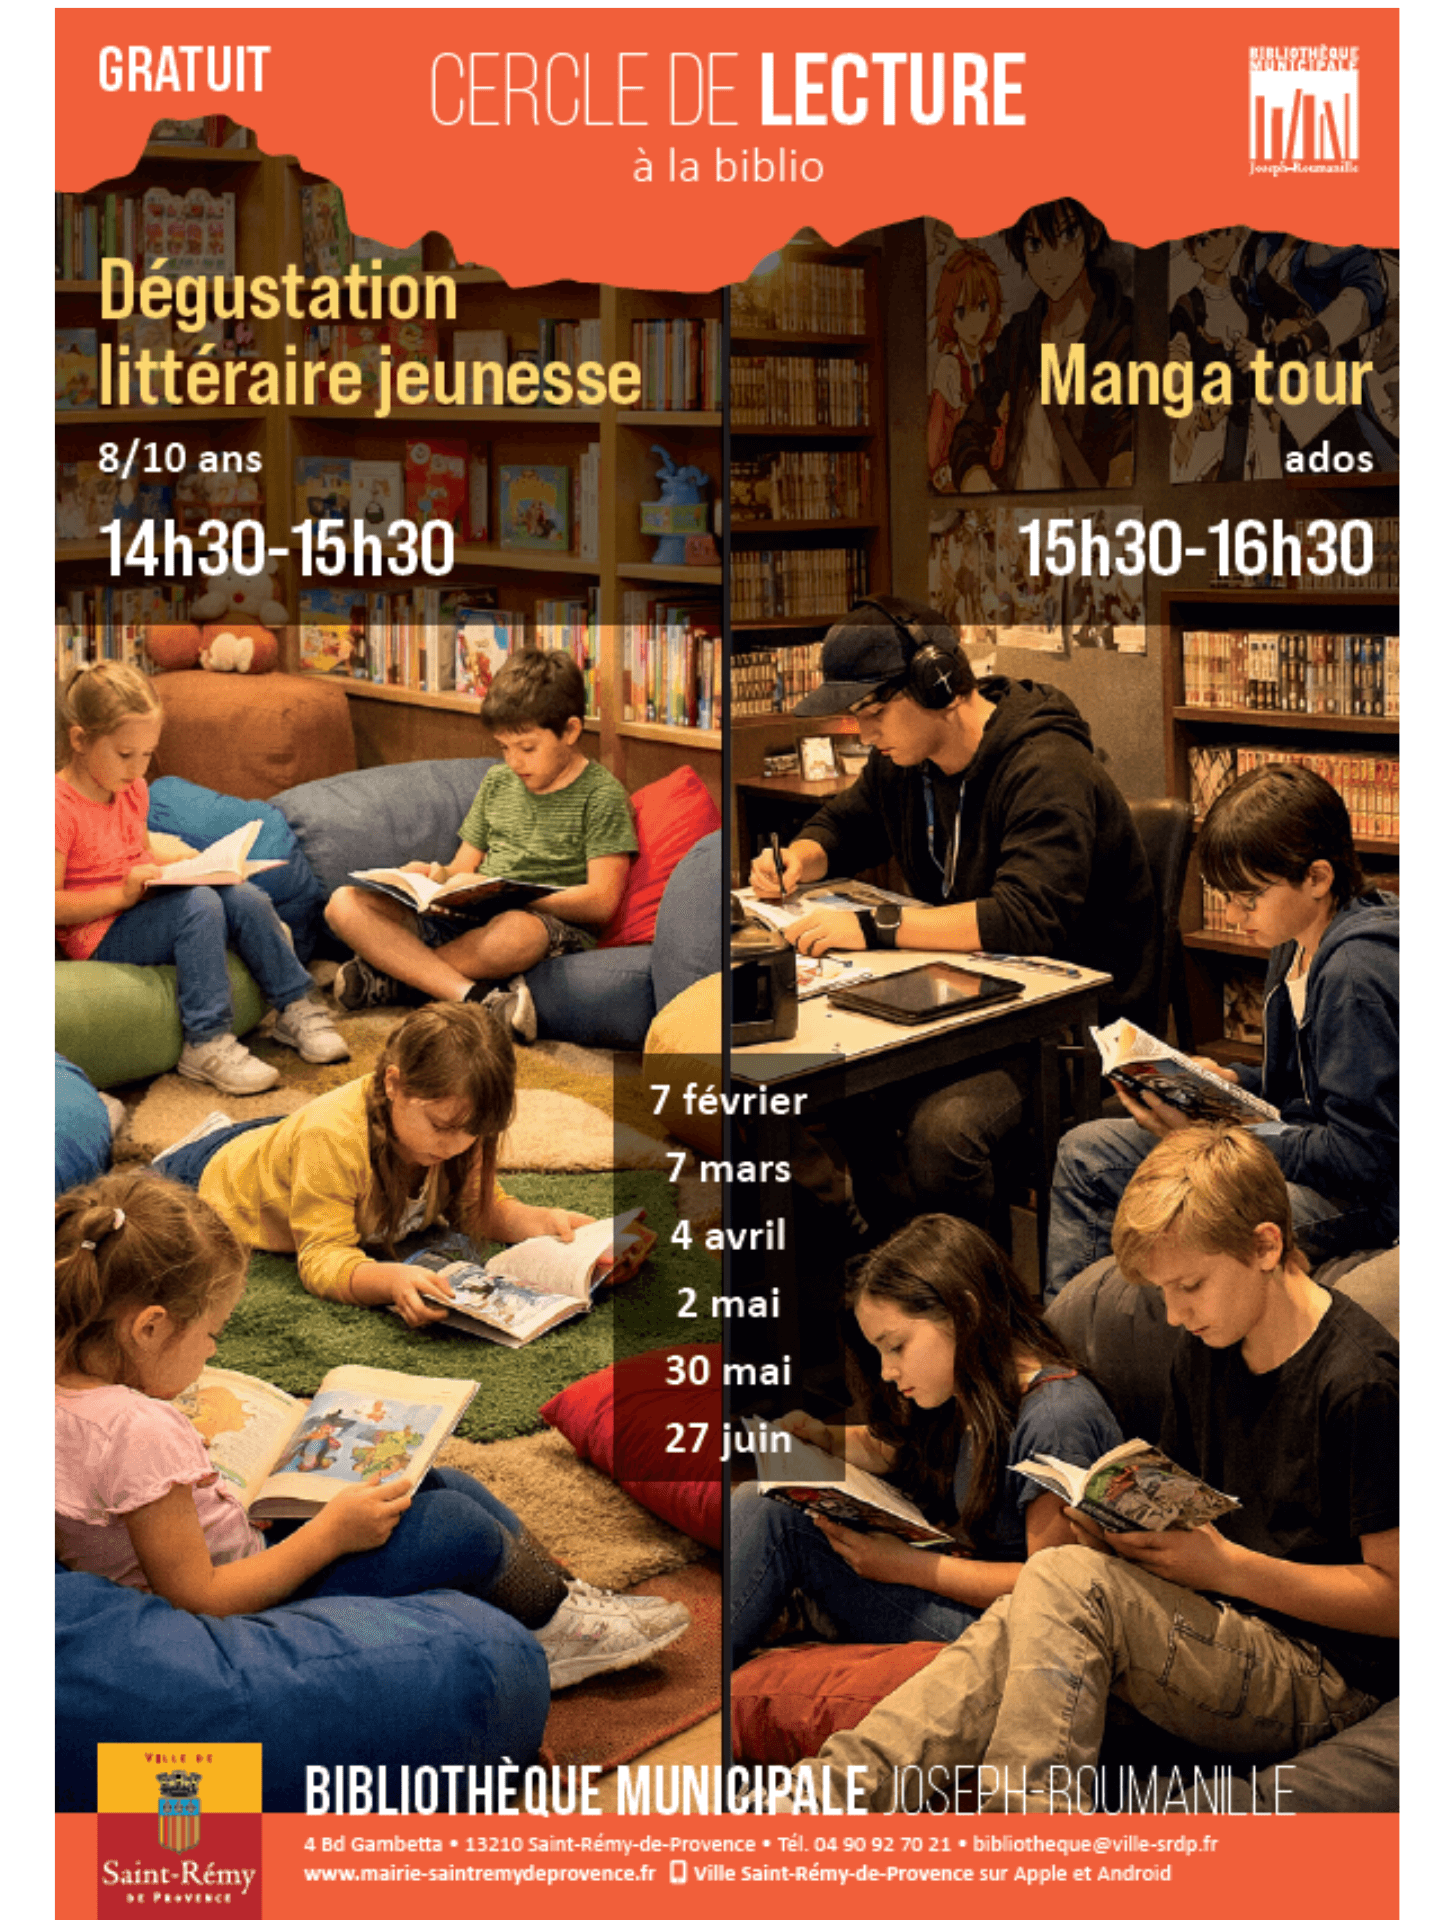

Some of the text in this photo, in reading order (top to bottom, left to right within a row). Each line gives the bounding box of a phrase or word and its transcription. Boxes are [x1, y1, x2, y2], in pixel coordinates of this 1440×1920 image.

[99, 45, 271, 92] GRATUIT
[431, 52, 1026, 126] CERCLE DE LECTURE
[633, 146, 824, 182] à la biblio
[101, 257, 456, 333] Dégustation
[102, 343, 641, 418] littéraire jeunesse
[1041, 343, 1373, 418] Manga tour
[98, 438, 262, 480] 8/10 ans
[1286, 440, 1374, 473] ados
[99, 518, 454, 577] 14h30-15h30
[1018, 518, 1374, 577] 15h30-16h30
[650, 1082, 808, 1115] 7 février
[666, 1151, 790, 1183] 7 mars
[671, 1217, 784, 1250] 4 avril
[678, 1287, 779, 1318] 2 mai
[666, 1354, 790, 1386] 30 mai
[666, 1422, 791, 1462] 27 juin
[306, 1756, 1296, 1818] BIBLIOTHÈQUE MUNICIPALE JOSEPH-ROUMANILLE
[304, 1832, 1218, 1856] 4 Bd Gambetta 13210 Saint-Rémy-de-Provence Tél. 04 90 92 70 21 bibliotheque@ville-srdp.fr
[103, 1860, 256, 1895] Saint-Rémy
[303, 1862, 1171, 1886] www.mairie-saintremydeprovence.fr Ville Saint-Rémy-de-Provence sur Apple et Android
